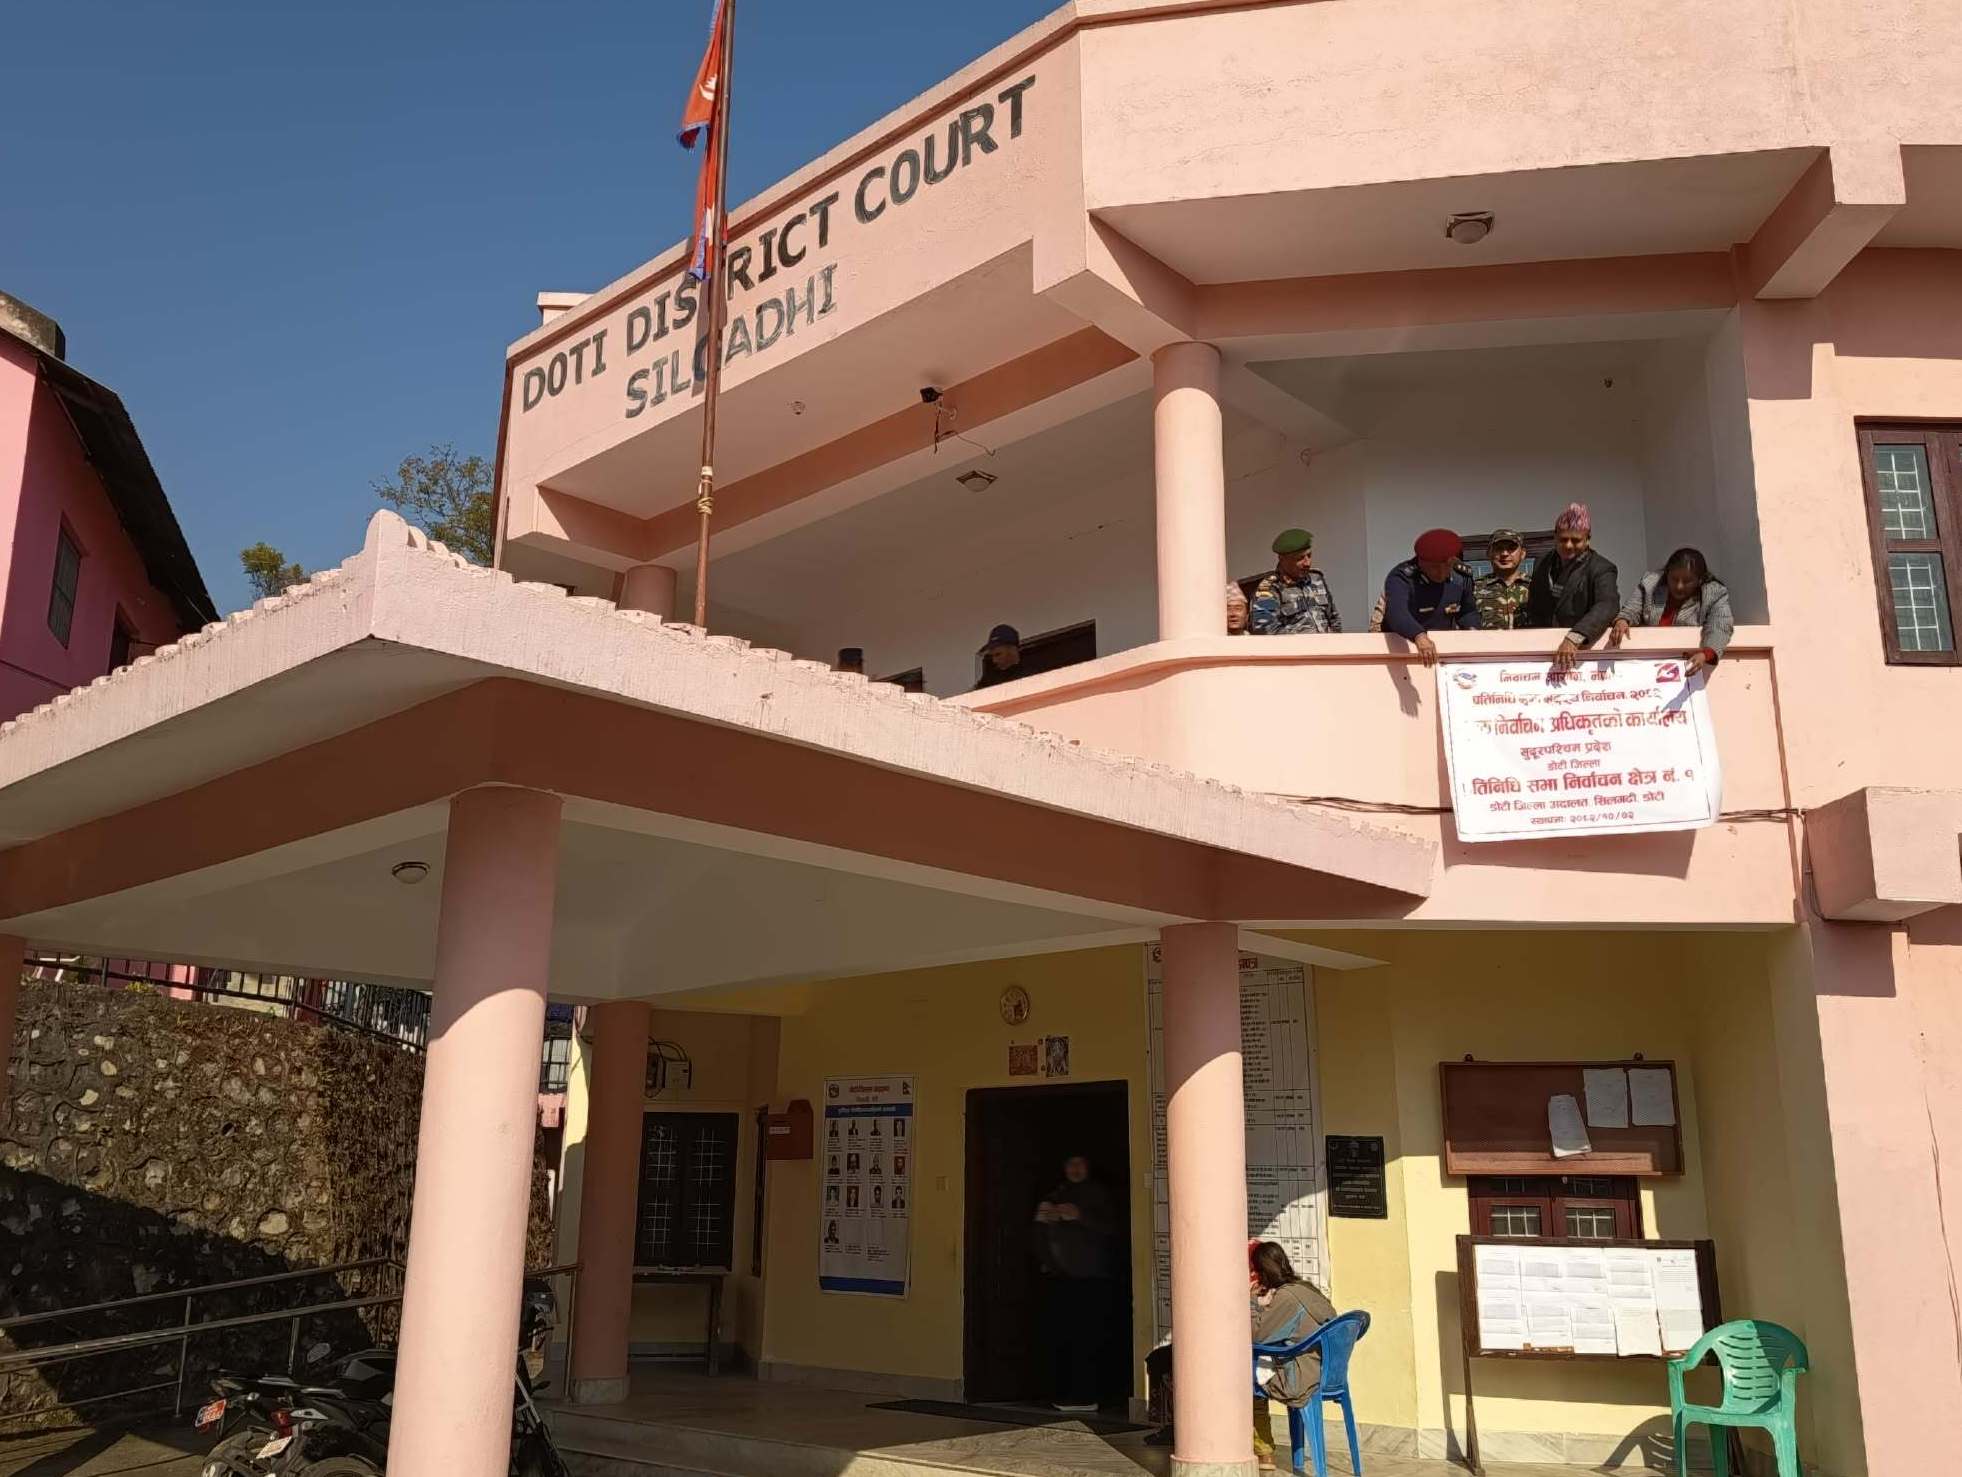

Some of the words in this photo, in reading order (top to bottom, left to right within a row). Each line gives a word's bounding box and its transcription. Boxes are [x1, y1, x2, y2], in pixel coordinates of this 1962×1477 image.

[522, 328, 608, 413] DOTI
[625, 191, 840, 357] DISRICT
[854, 75, 1037, 225] COURT
[1563, 771, 1623, 791] निर्वाचन
[1628, 767, 1658, 785] क्षेत्र
